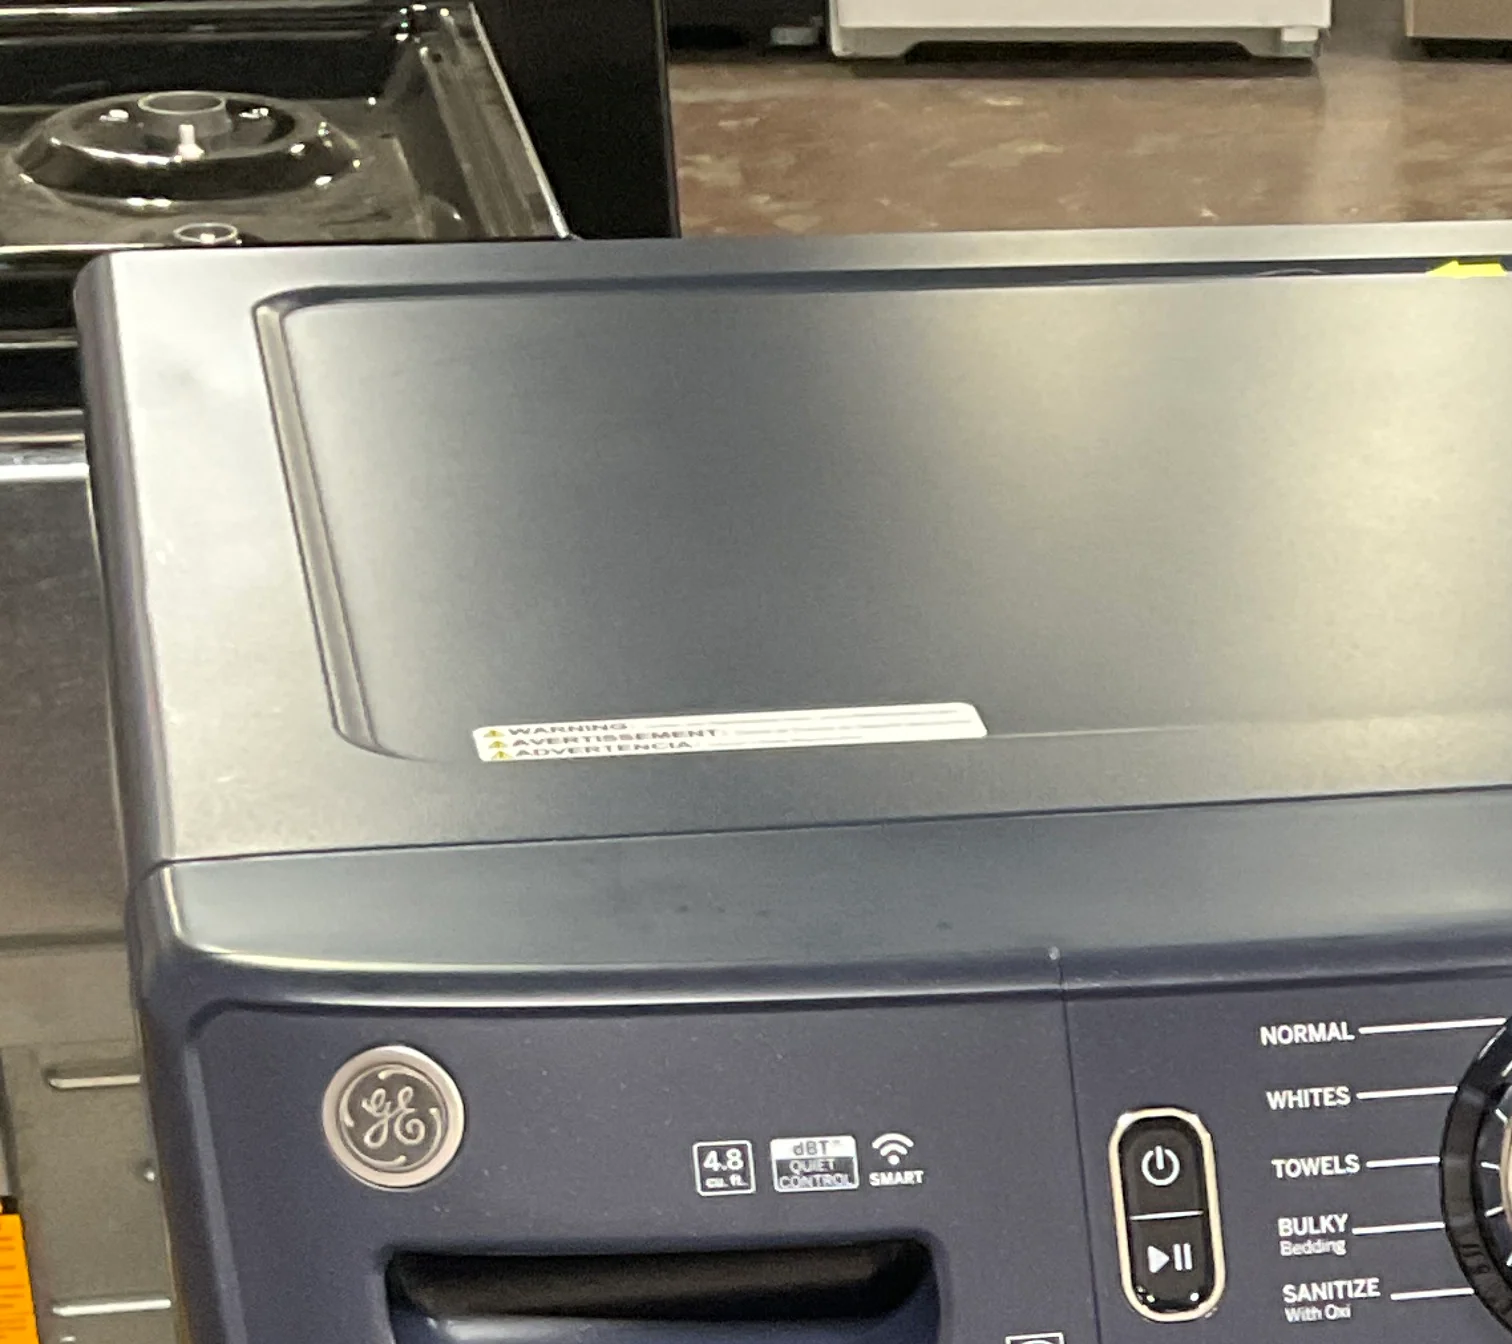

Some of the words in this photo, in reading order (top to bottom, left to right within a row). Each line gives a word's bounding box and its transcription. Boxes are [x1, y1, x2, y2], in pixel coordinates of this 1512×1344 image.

[1260, 1022, 1355, 1046] NORMAL
[1266, 1086, 1351, 1110] WHITES
[702, 1148, 744, 1172] 4.8
[789, 1159, 835, 1173] QUIET
[1271, 1154, 1360, 1178] TOWELS
[779, 1173, 850, 1188] CONTROL
[869, 1170, 924, 1187] SMART
[1277, 1213, 1349, 1238] BULKY
[1280, 1239, 1347, 1257] Bedding
[1282, 1277, 1381, 1304] SANITIZE
[1284, 1307, 1323, 1323] With
[1324, 1303, 1351, 1320] Oxi
